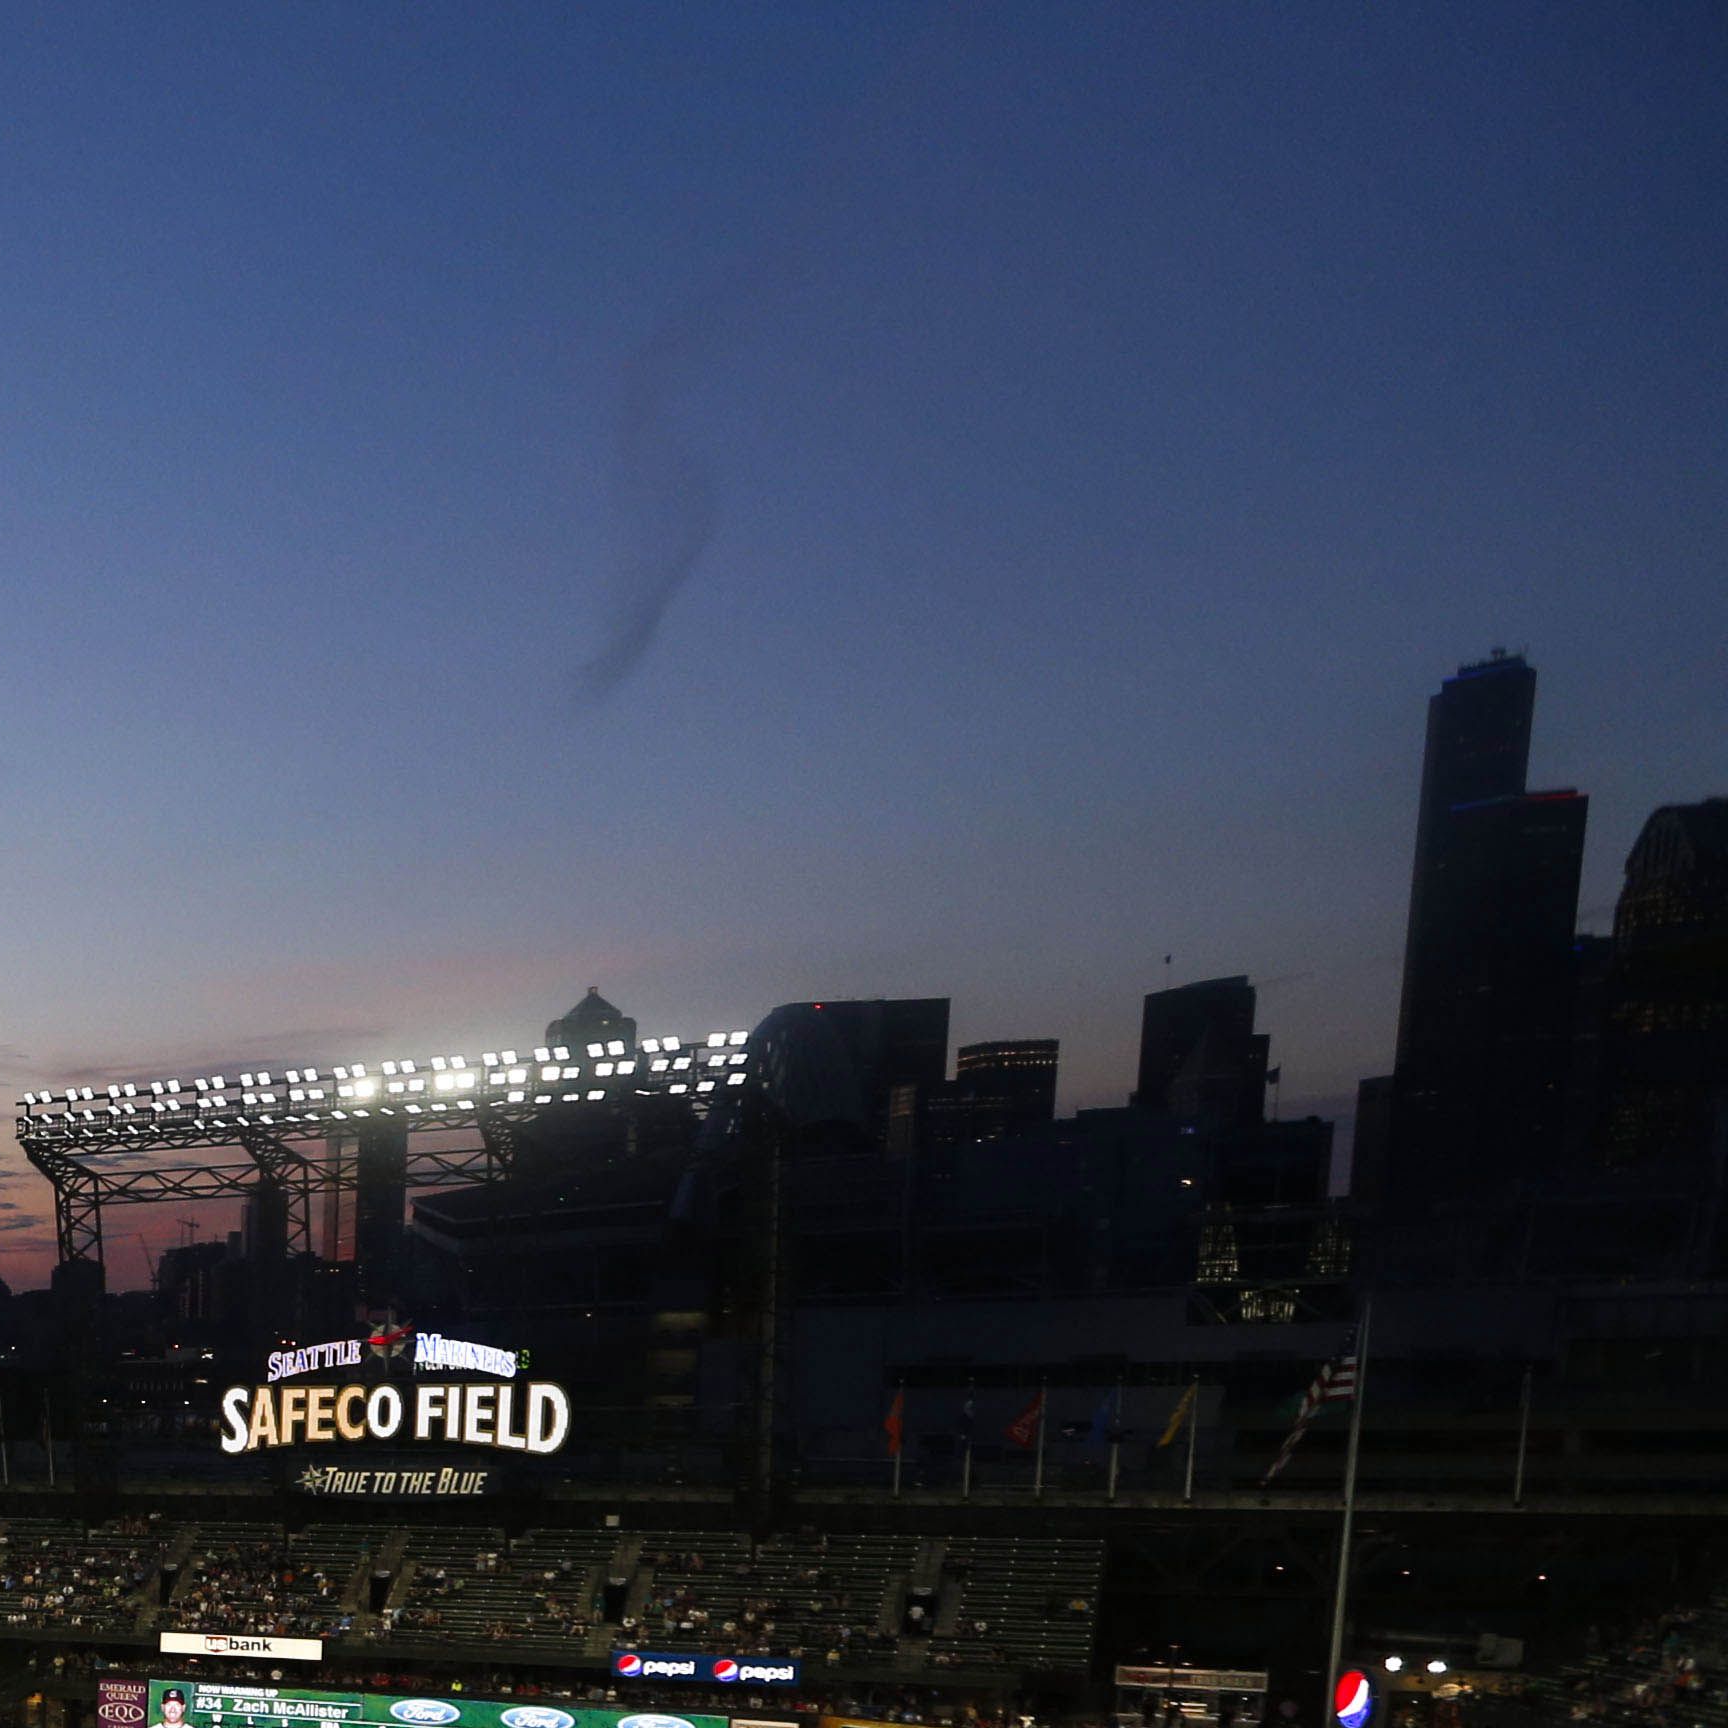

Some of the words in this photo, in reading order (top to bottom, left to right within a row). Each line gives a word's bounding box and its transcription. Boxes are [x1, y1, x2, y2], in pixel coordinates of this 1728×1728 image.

[268, 1340, 361, 1382] SEATTLE
[414, 1333, 517, 1378] MARINERS
[221, 1384, 404, 1454] SAFECO
[414, 1382, 571, 1454] FIELD
[324, 1467, 373, 1494] TRUE
[374, 1470, 395, 1493] TO
[399, 1471, 437, 1494] THE
[438, 1467, 488, 1495] BLUE
[643, 1660, 695, 1677] pepsi
[739, 1665, 794, 1682] pepsi
[100, 1682, 145, 1694] EMERALD
[106, 1691, 138, 1701] QUEEN
[198, 1684, 220, 1694] NOW
[221, 1686, 265, 1697] WARMING
[266, 1688, 279, 1698] UP
[104, 1704, 143, 1722] EQC
[196, 1697, 222, 1710] #34
[232, 1699, 269, 1714] Zach
[273, 1702, 349, 1719] McAllister
[403, 1704, 446, 1722] Ford
[211, 1713, 223, 1723] W
[247, 1716, 254, 1725] L
